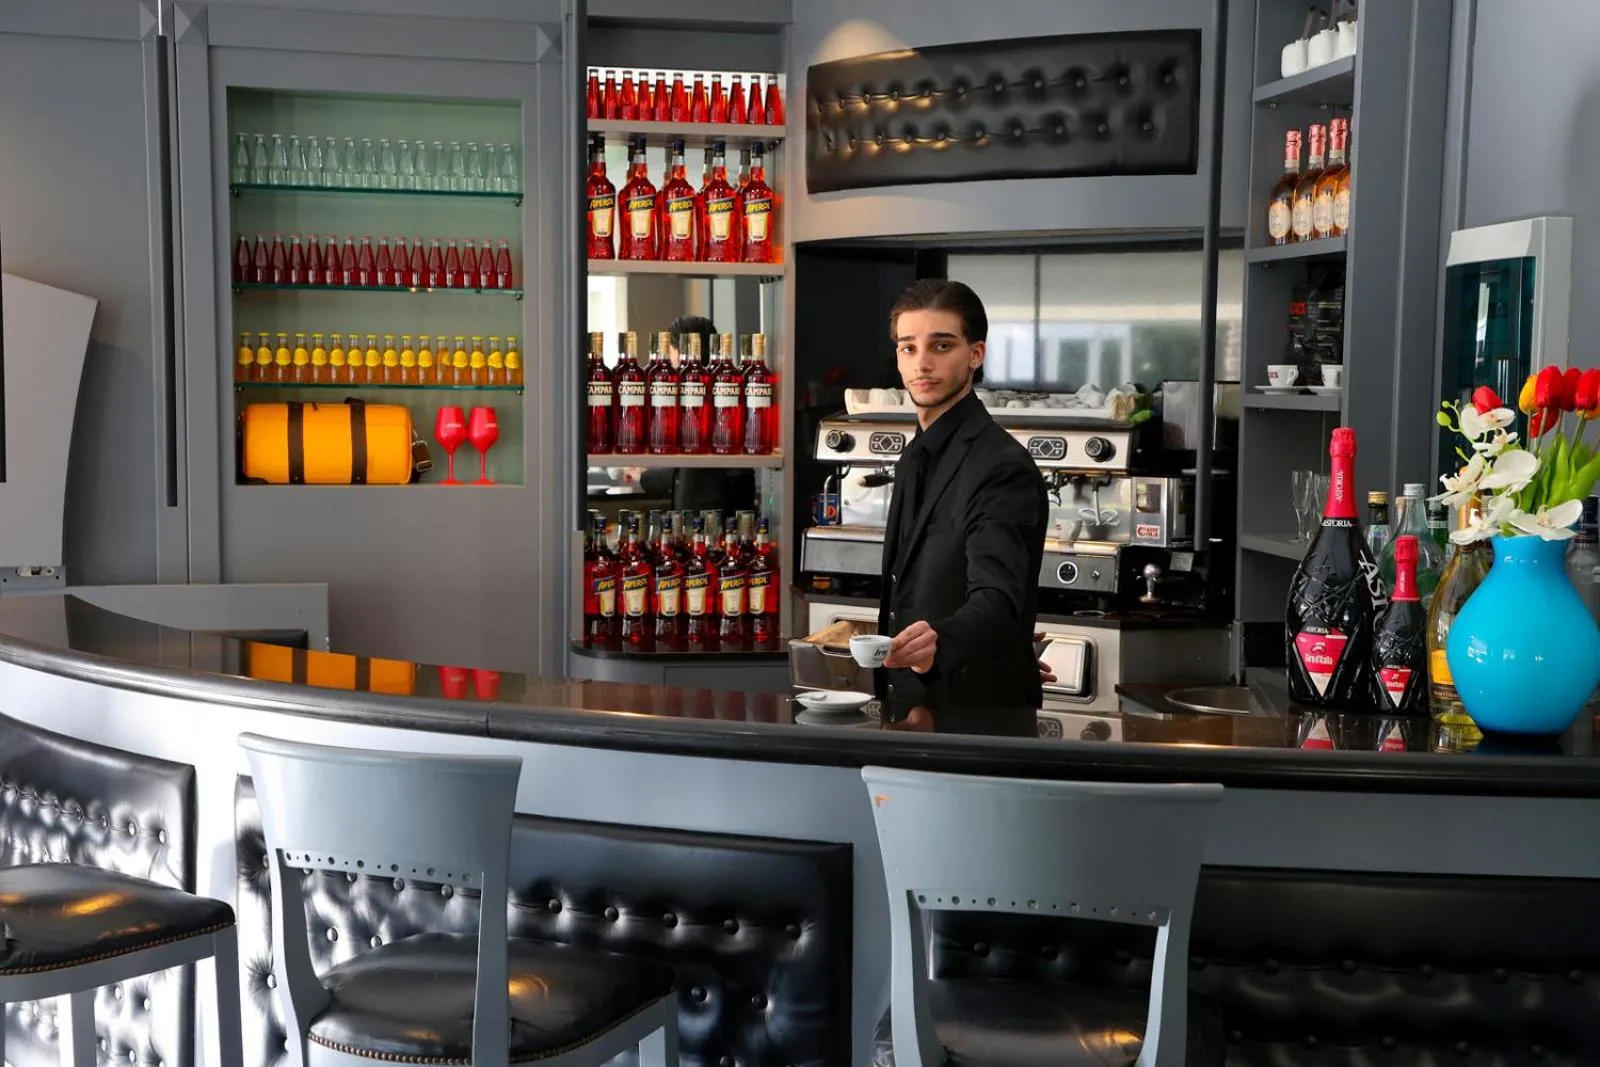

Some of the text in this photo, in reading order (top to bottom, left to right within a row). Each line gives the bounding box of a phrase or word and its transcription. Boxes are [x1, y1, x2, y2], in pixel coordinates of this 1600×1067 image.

[590, 198, 614, 209] APEROL
[628, 199, 654, 210] APEROL
[669, 201, 693, 212] APEROL
[709, 202, 733, 213] APEROL
[746, 203, 770, 214] APEROL
[1322, 519, 1352, 528] ASTORIA
